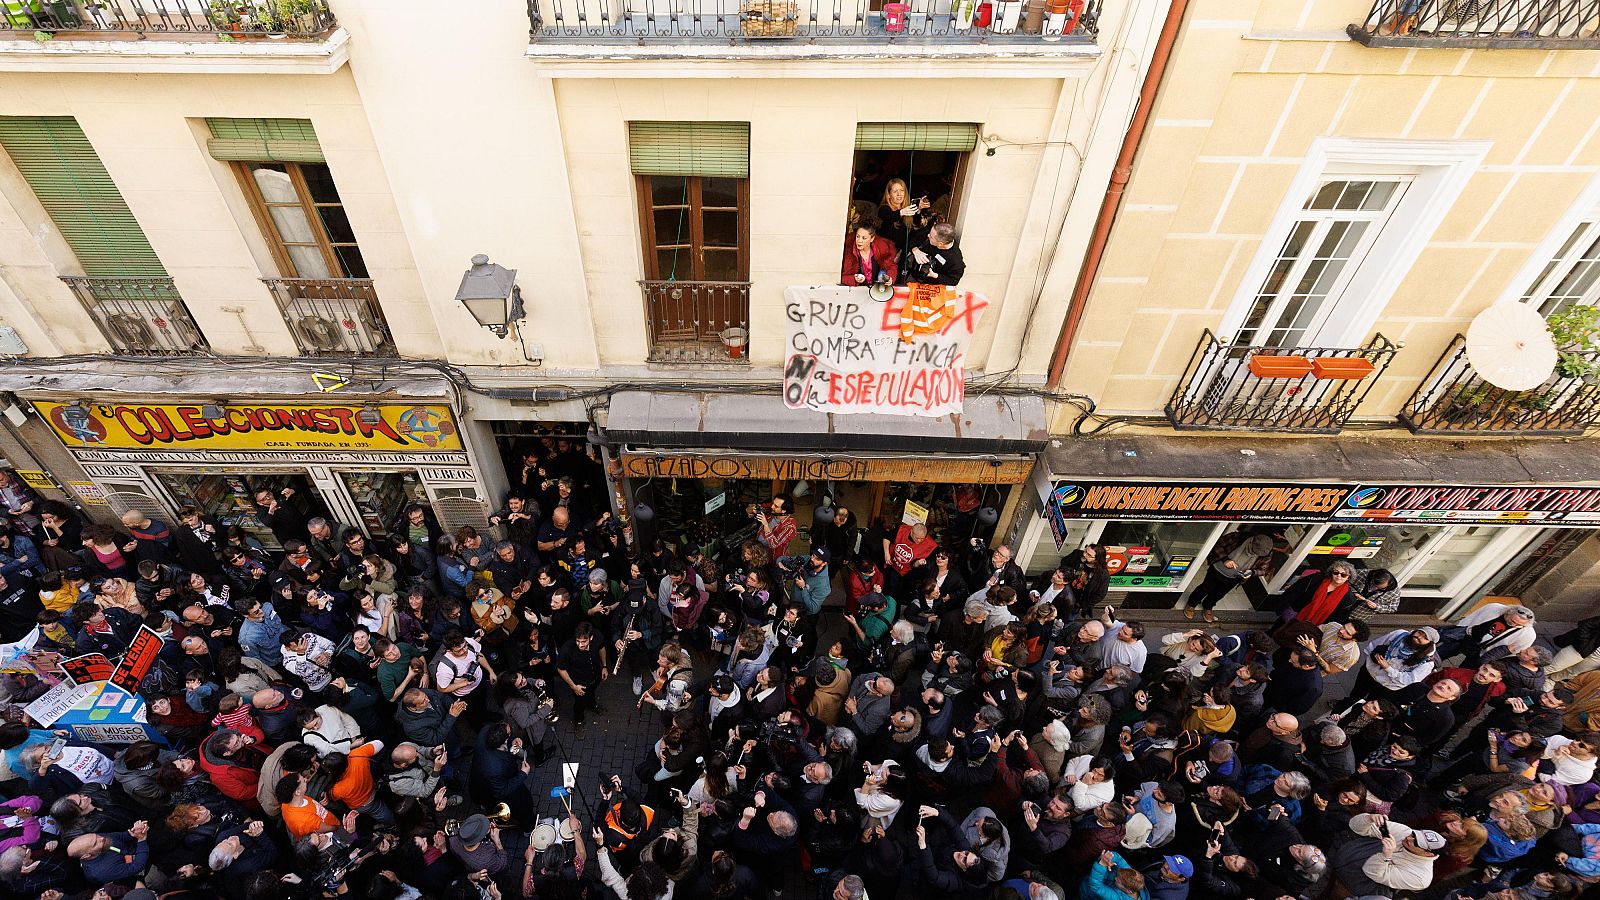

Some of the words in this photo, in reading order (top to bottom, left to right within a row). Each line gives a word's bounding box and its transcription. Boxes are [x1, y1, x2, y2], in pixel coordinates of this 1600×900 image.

[785, 301, 866, 330] GRUPO
[792, 331, 875, 364] COMPRA
[114, 405, 410, 446] COLECCIONISTA
[77, 451, 122, 460] COMICS
[126, 452, 175, 460] COMPRA
[350, 453, 417, 462] NOVEDADES
[422, 454, 467, 462] COMICS
[627, 457, 752, 477] CALZADOS
[87, 465, 139, 476] TEBEOS
[424, 468, 474, 480] TEBEOS
[1081, 485, 1171, 510] NOWSHINE
[1161, 487, 1226, 511] DIGITAL
[1217, 487, 1301, 512] PRINTING
[1295, 488, 1349, 513] PRESS
[1376, 487, 1489, 510] NOWSHINE
[1473, 488, 1551, 511] MONEY
[896, 545, 912, 559] STOP
[64, 660, 85, 671] SE
[114, 666, 130, 685] SE
[122, 629, 151, 667] VENDE
[39, 688, 84, 723] TRIBULETE
[102, 726, 143, 735] MUSEO
